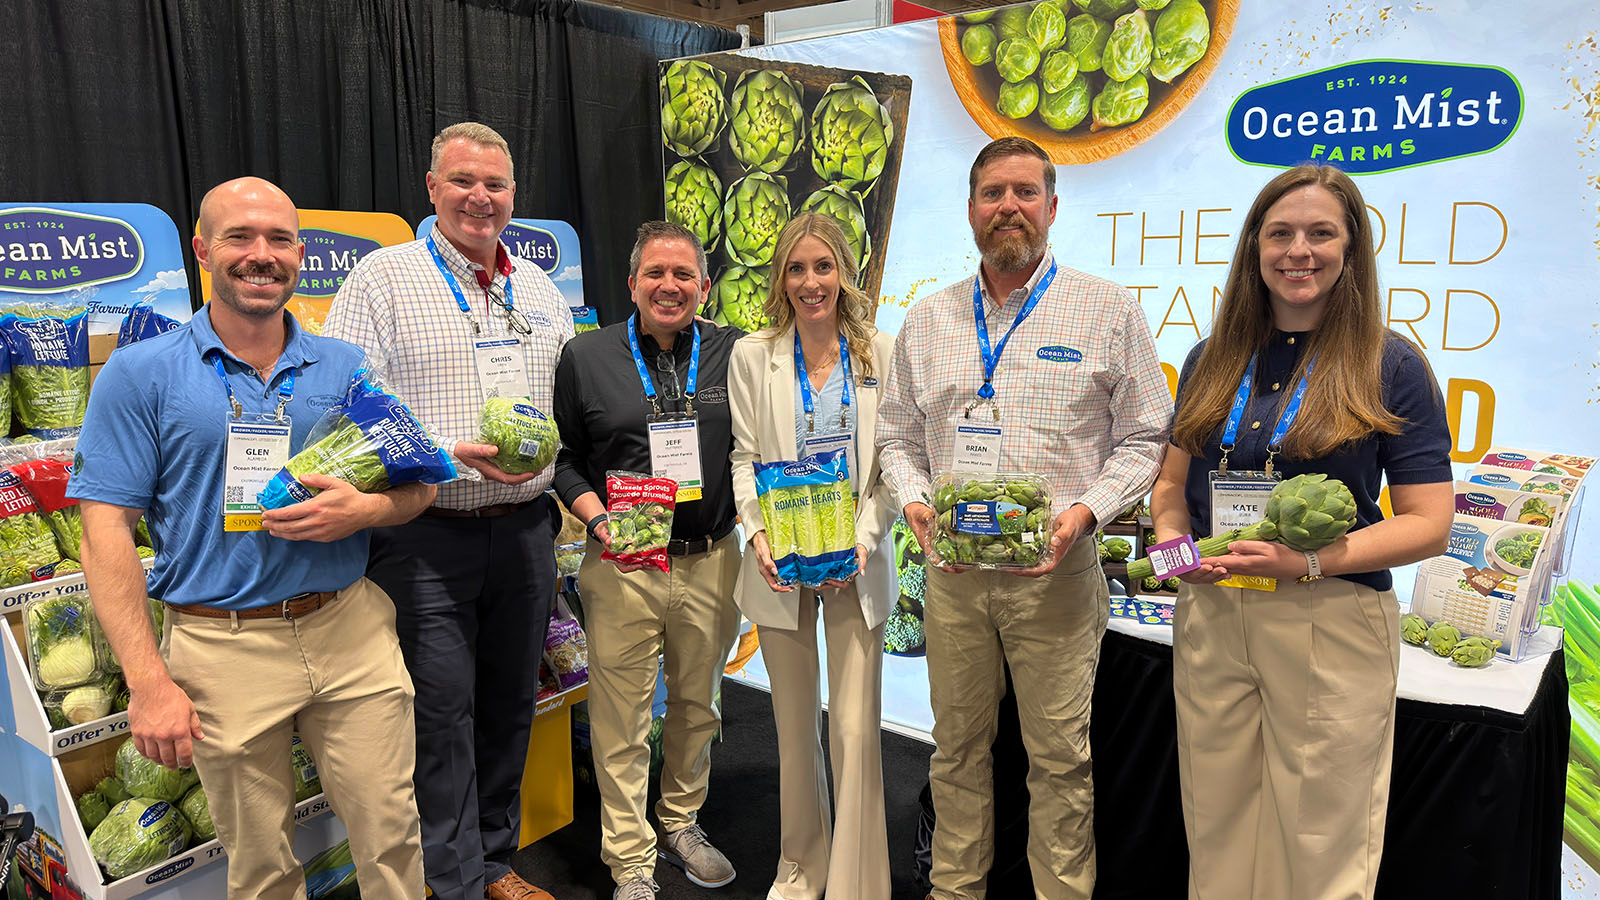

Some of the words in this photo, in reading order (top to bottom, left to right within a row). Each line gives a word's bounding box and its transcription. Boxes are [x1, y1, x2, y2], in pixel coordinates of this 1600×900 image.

[1326, 78, 1360, 91] EST.
[1369, 75, 1408, 84] 1924
[1243, 106, 1378, 140] Ocean
[1310, 139, 1416, 161] FARMS
[4, 222, 30, 230] EST.
[36, 221, 64, 230] 1924
[1097, 208, 1232, 266] THE
[4, 266, 82, 280] FARMS
[299, 276, 345, 288] ARMS
[378, 418, 416, 456] ROMAINE
[246, 448, 270, 456] GLEN
[642, 492, 674, 501] Bruxelles
[644, 484, 670, 492] Sprouts
[774, 496, 810, 511] ROMAINE
[811, 490, 842, 505] HEARTS
[1452, 548, 1474, 558] SERVICE
[4, 590, 50, 608] Offer
[55, 582, 88, 594] You
[58, 728, 104, 748] Offer
[148, 868, 174, 882] Ocean
[174, 859, 193, 870] Mist
